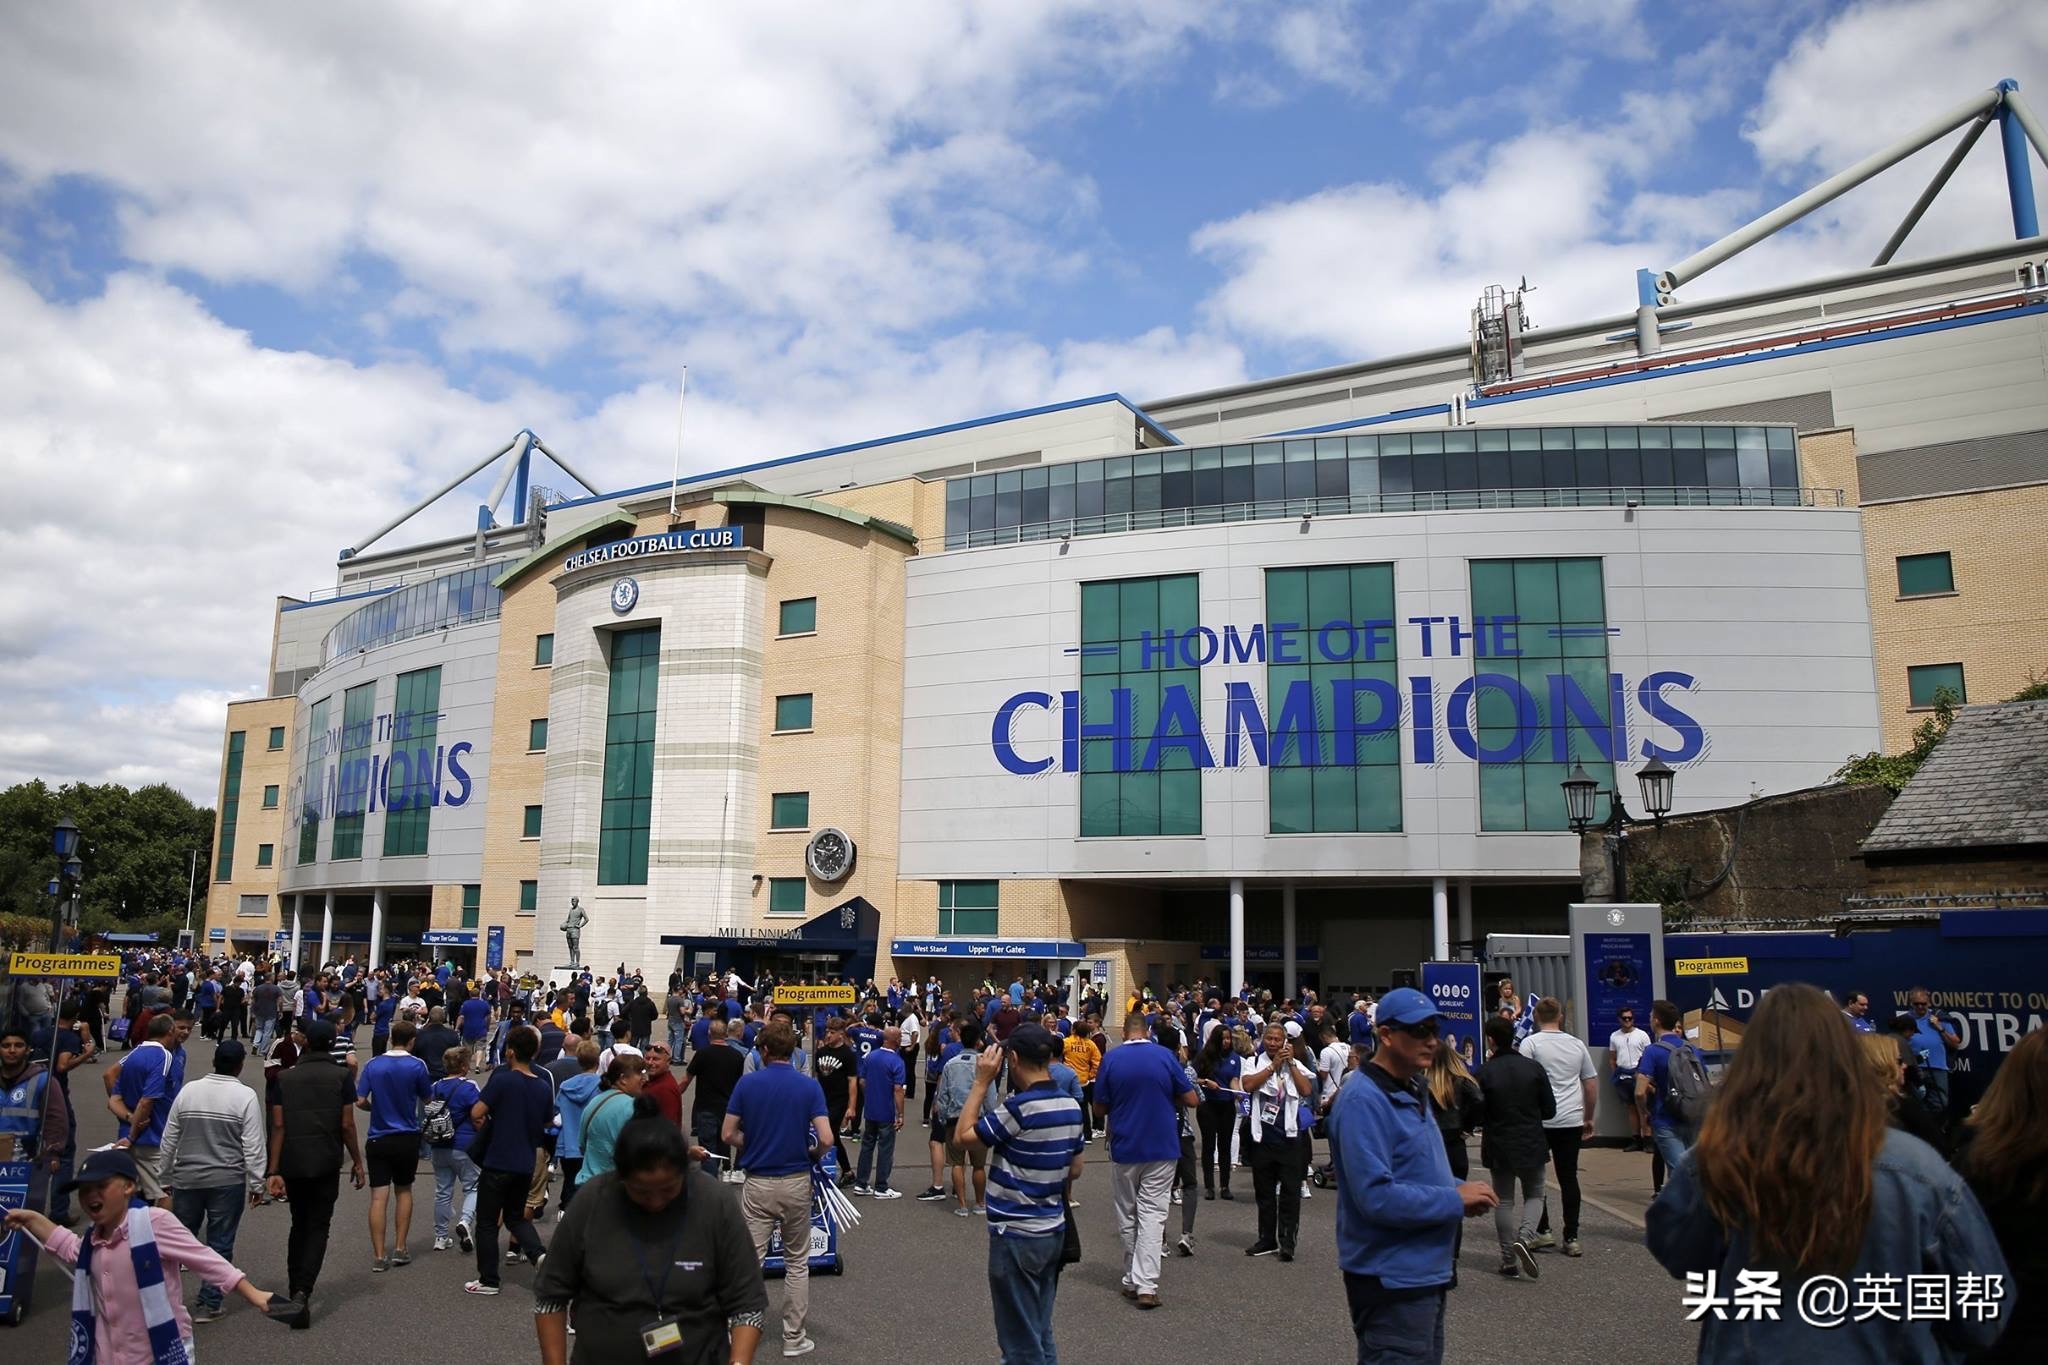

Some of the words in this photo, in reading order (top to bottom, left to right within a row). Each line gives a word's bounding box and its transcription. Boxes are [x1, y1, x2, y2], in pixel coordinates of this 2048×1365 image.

[564, 548, 613, 571] CHELSEA
[611, 535, 686, 559] FOOTBALL
[689, 531, 733, 548] CLUB
[1141, 621, 1300, 669] HOME
[1317, 619, 1394, 662] OF
[1409, 615, 1523, 658] THE
[991, 671, 1708, 775] CHAMPIONS
[719, 927, 803, 940] MILLENNIUM
[913, 945, 929, 953] West
[929, 945, 948, 953] Stand
[968, 945, 990, 955] Upper
[990, 945, 1004, 953] Tier
[1005, 945, 1026, 954] Gates
[15, 955, 115, 973] Programmes
[1678, 961, 1745, 972] Programmes
[777, 988, 852, 1001] Programmes
[1998, 993, 2023, 1009] TO
[860, 1041, 872, 1058] 9
[1070, 1045, 1091, 1053] HELP
[10, 1166, 25, 1177] FC
